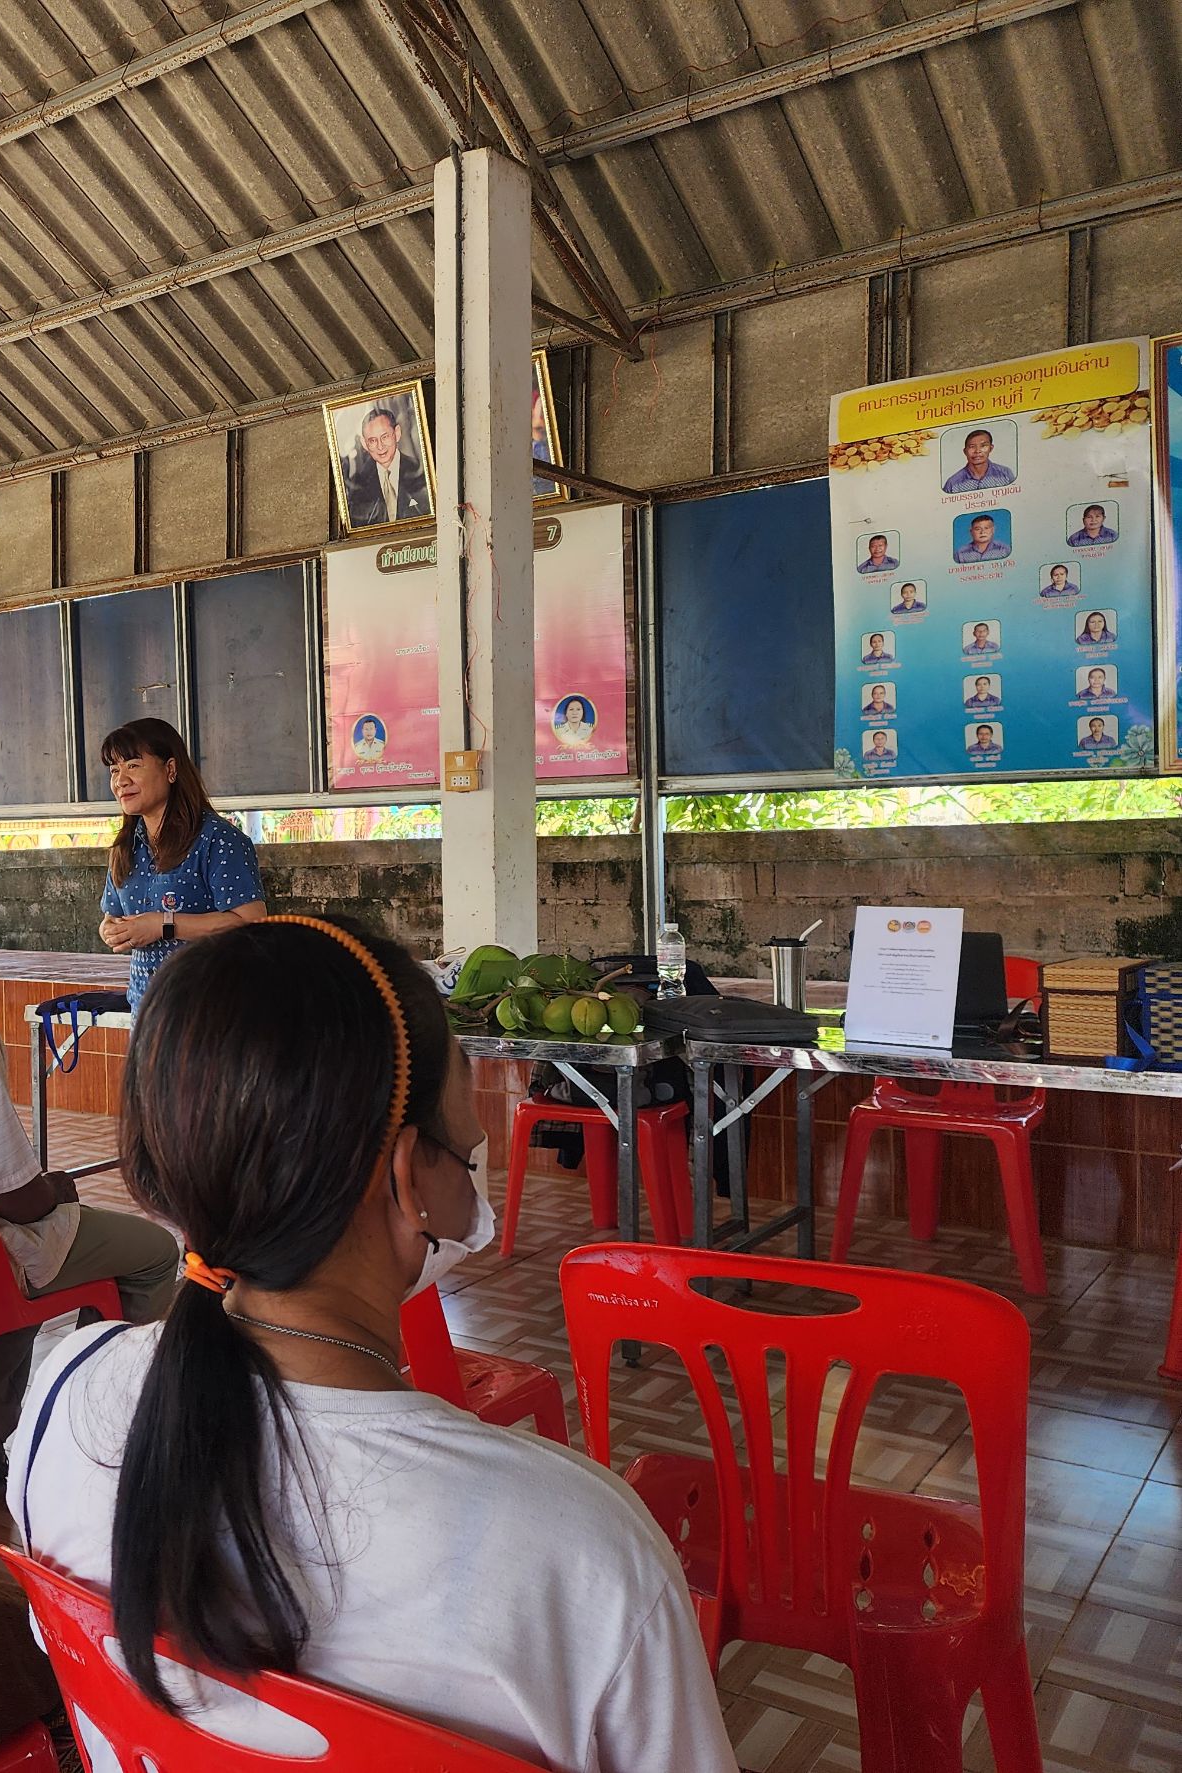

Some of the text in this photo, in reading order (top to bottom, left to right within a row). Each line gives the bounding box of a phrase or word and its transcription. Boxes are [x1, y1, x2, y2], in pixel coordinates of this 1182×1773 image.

[858, 352, 1109, 413] คณะกรรมการบริหารกองทุนเงินล้าน
[916, 386, 1041, 421] บ้านสำโรง หมู่ที่ 7
[547, 525, 557, 541] 7
